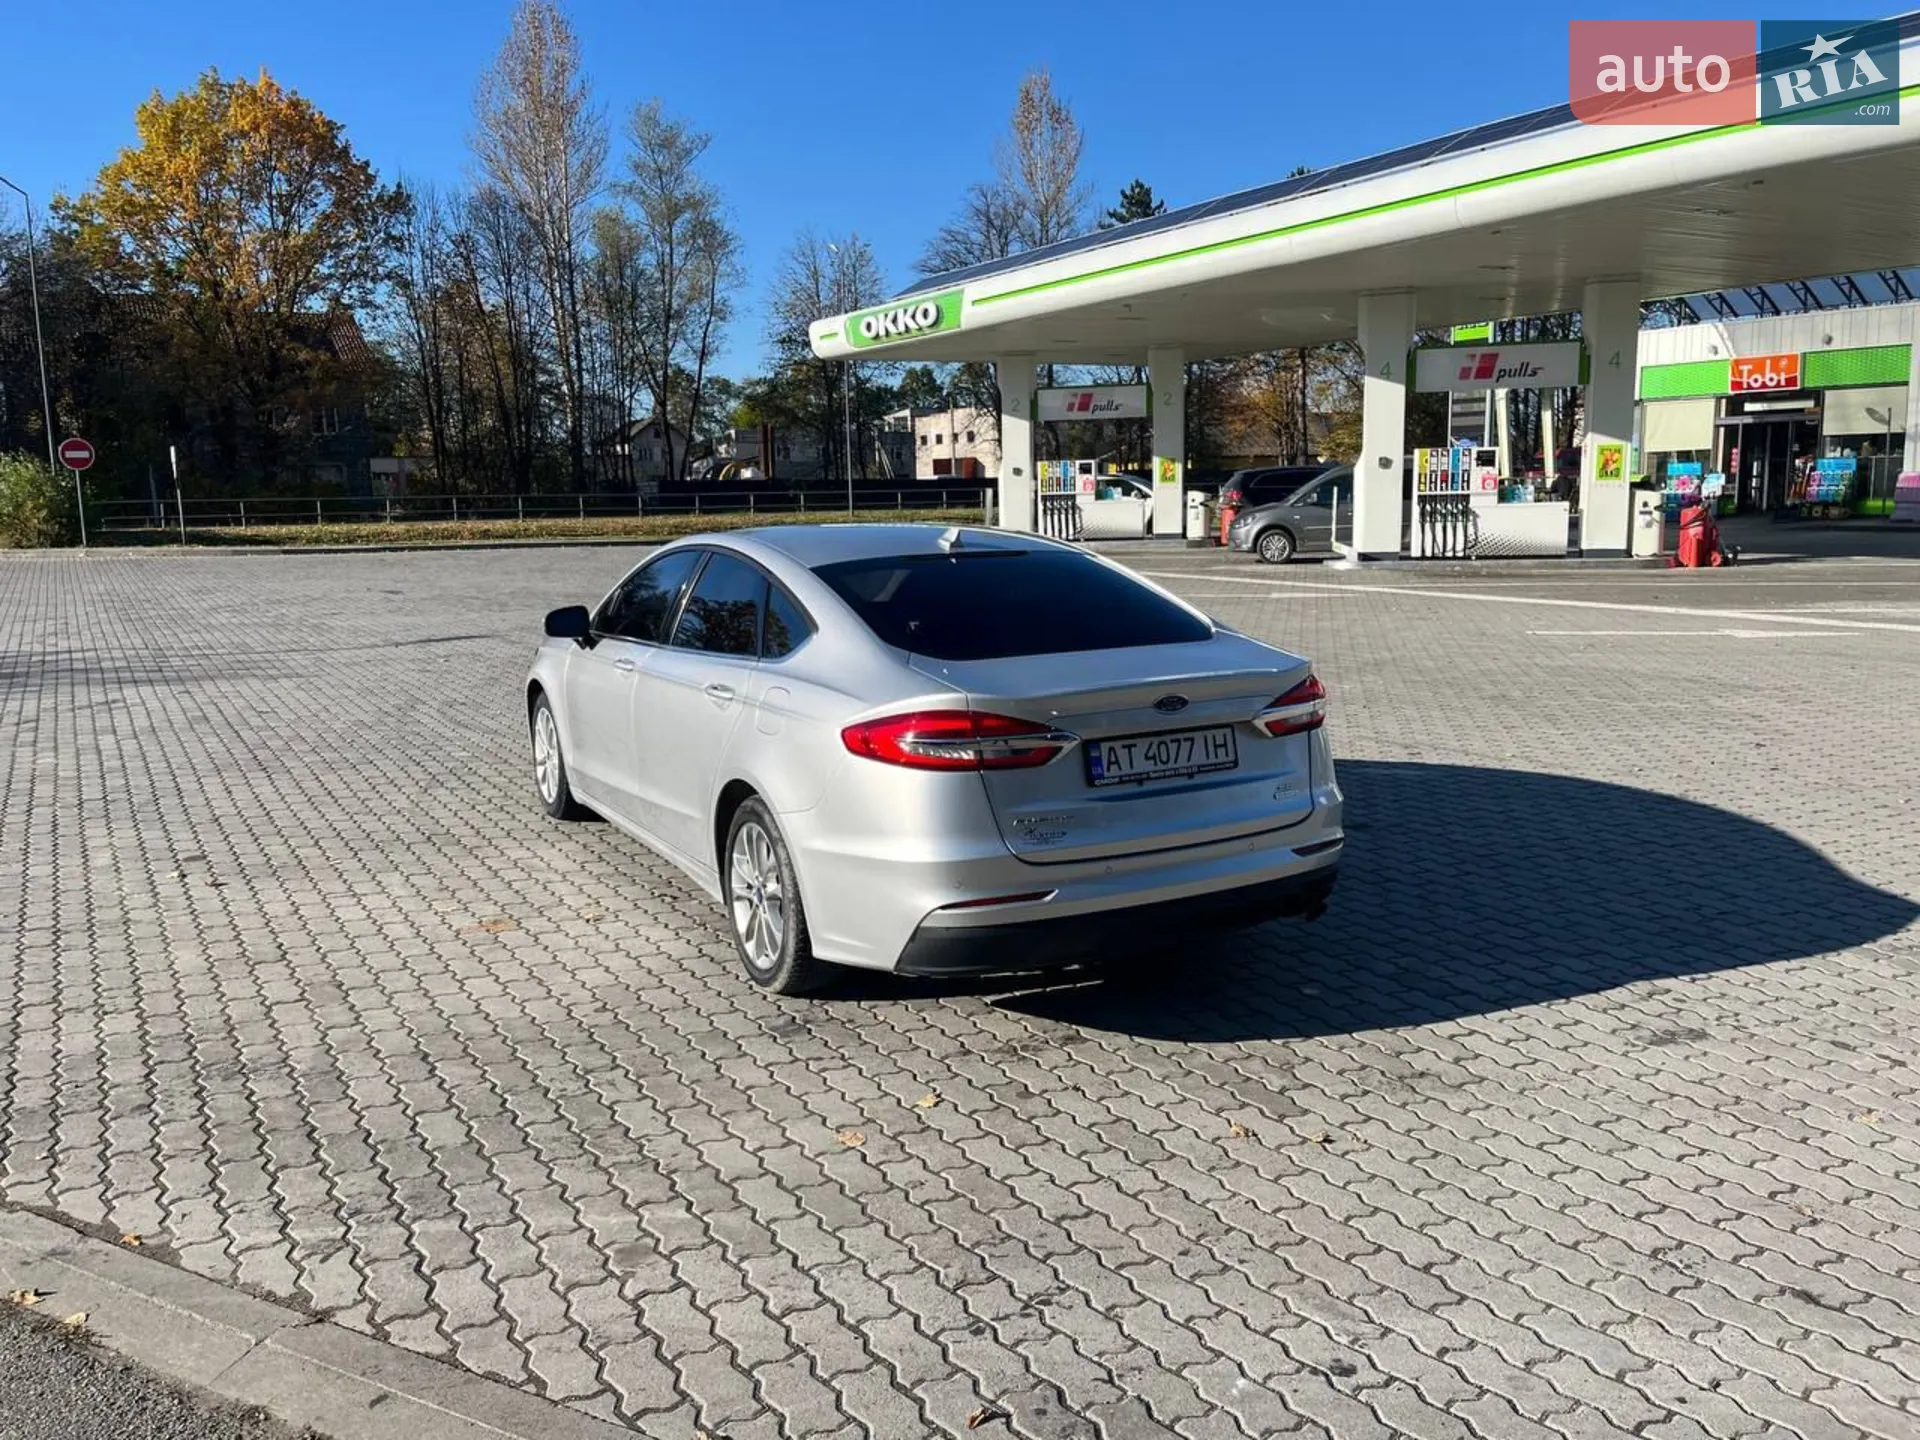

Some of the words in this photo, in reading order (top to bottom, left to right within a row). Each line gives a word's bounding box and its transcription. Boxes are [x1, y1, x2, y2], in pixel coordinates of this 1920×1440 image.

[859, 301, 938, 338] OKKO
[1607, 350, 1621, 369] 4
[1379, 362, 1392, 380] 4
[1495, 361, 1545, 383] pulls
[1738, 357, 1789, 389] Tobi
[1011, 399, 1021, 413] 2
[1091, 399, 1124, 415] pulls
[1163, 392, 1174, 406] 2
[1106, 743, 1137, 773] AT
[1144, 737, 1195, 766] 4077
[1203, 733, 1229, 760] IH
